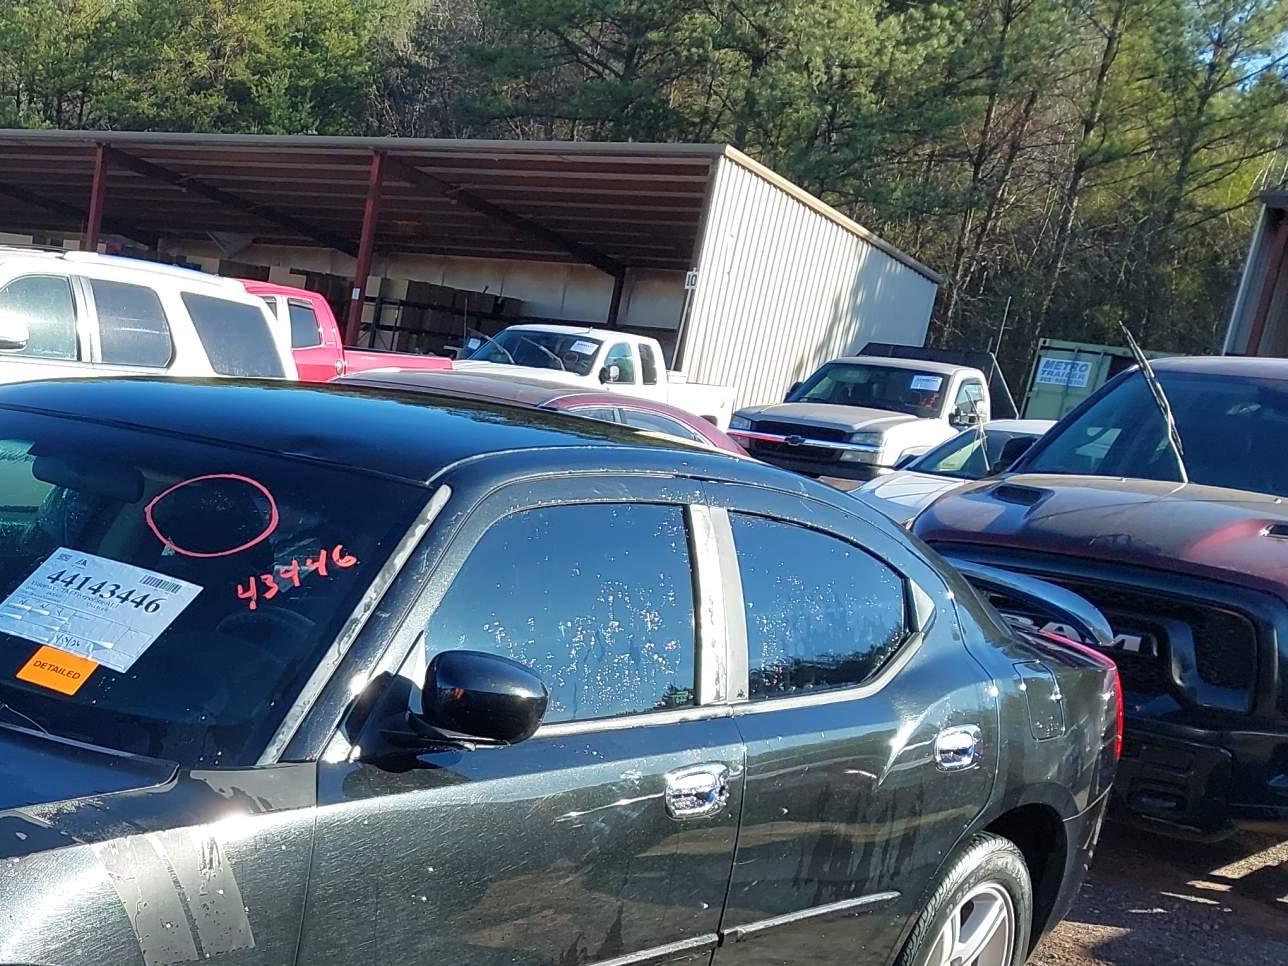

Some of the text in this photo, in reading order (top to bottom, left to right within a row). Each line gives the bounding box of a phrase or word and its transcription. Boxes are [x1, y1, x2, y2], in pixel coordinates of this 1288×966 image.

[1043, 359, 1089, 373] METRO
[46, 569, 167, 614] 44143446
[237, 544, 357, 610] 43446
[33, 660, 81, 680] DETAILED
